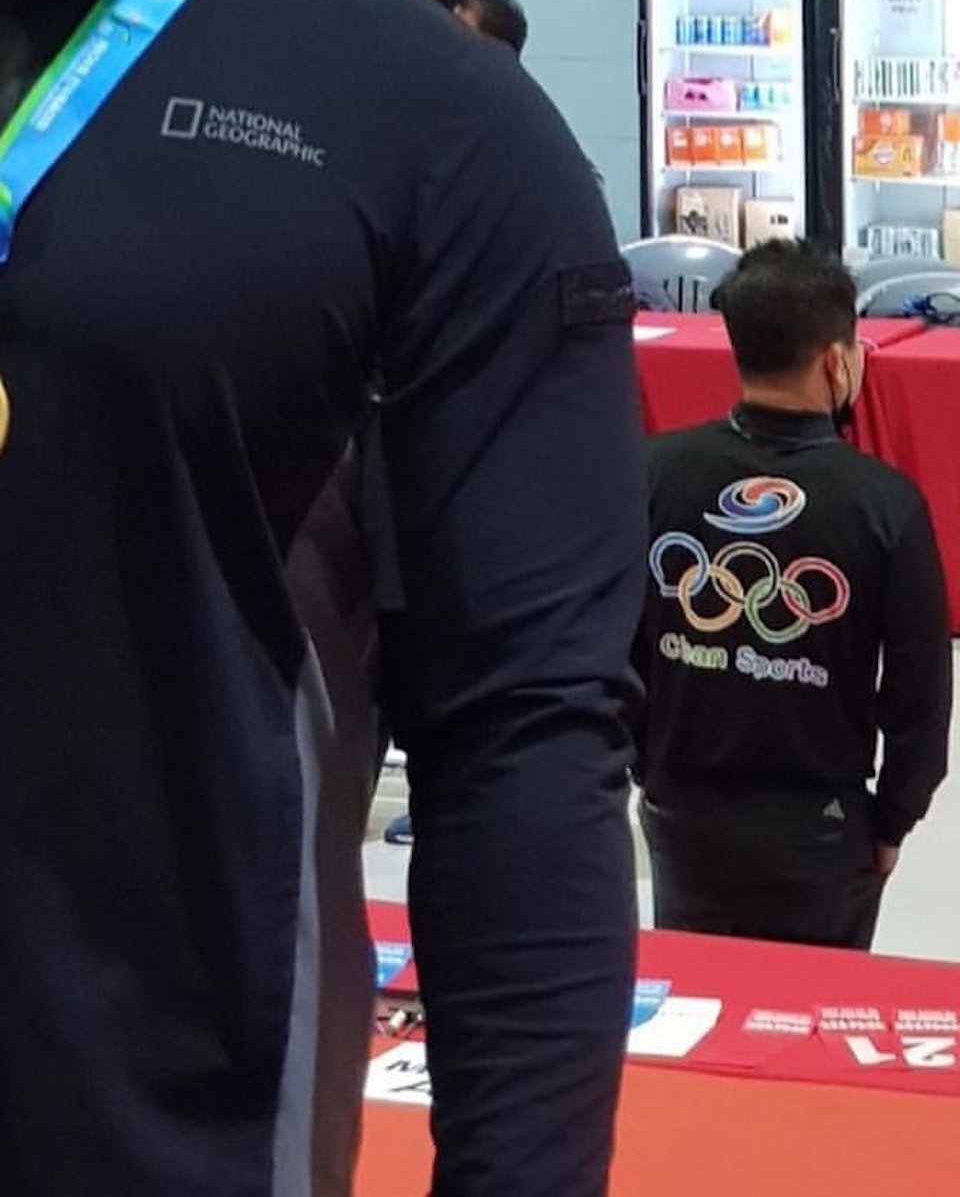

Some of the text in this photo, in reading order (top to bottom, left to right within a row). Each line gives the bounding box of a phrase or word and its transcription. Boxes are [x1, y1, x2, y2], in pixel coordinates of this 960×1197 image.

[208, 105, 303, 140] NATIONAL
[204, 122, 326, 166] GEOGRAPHIC
[735, 645, 829, 686] Sports
